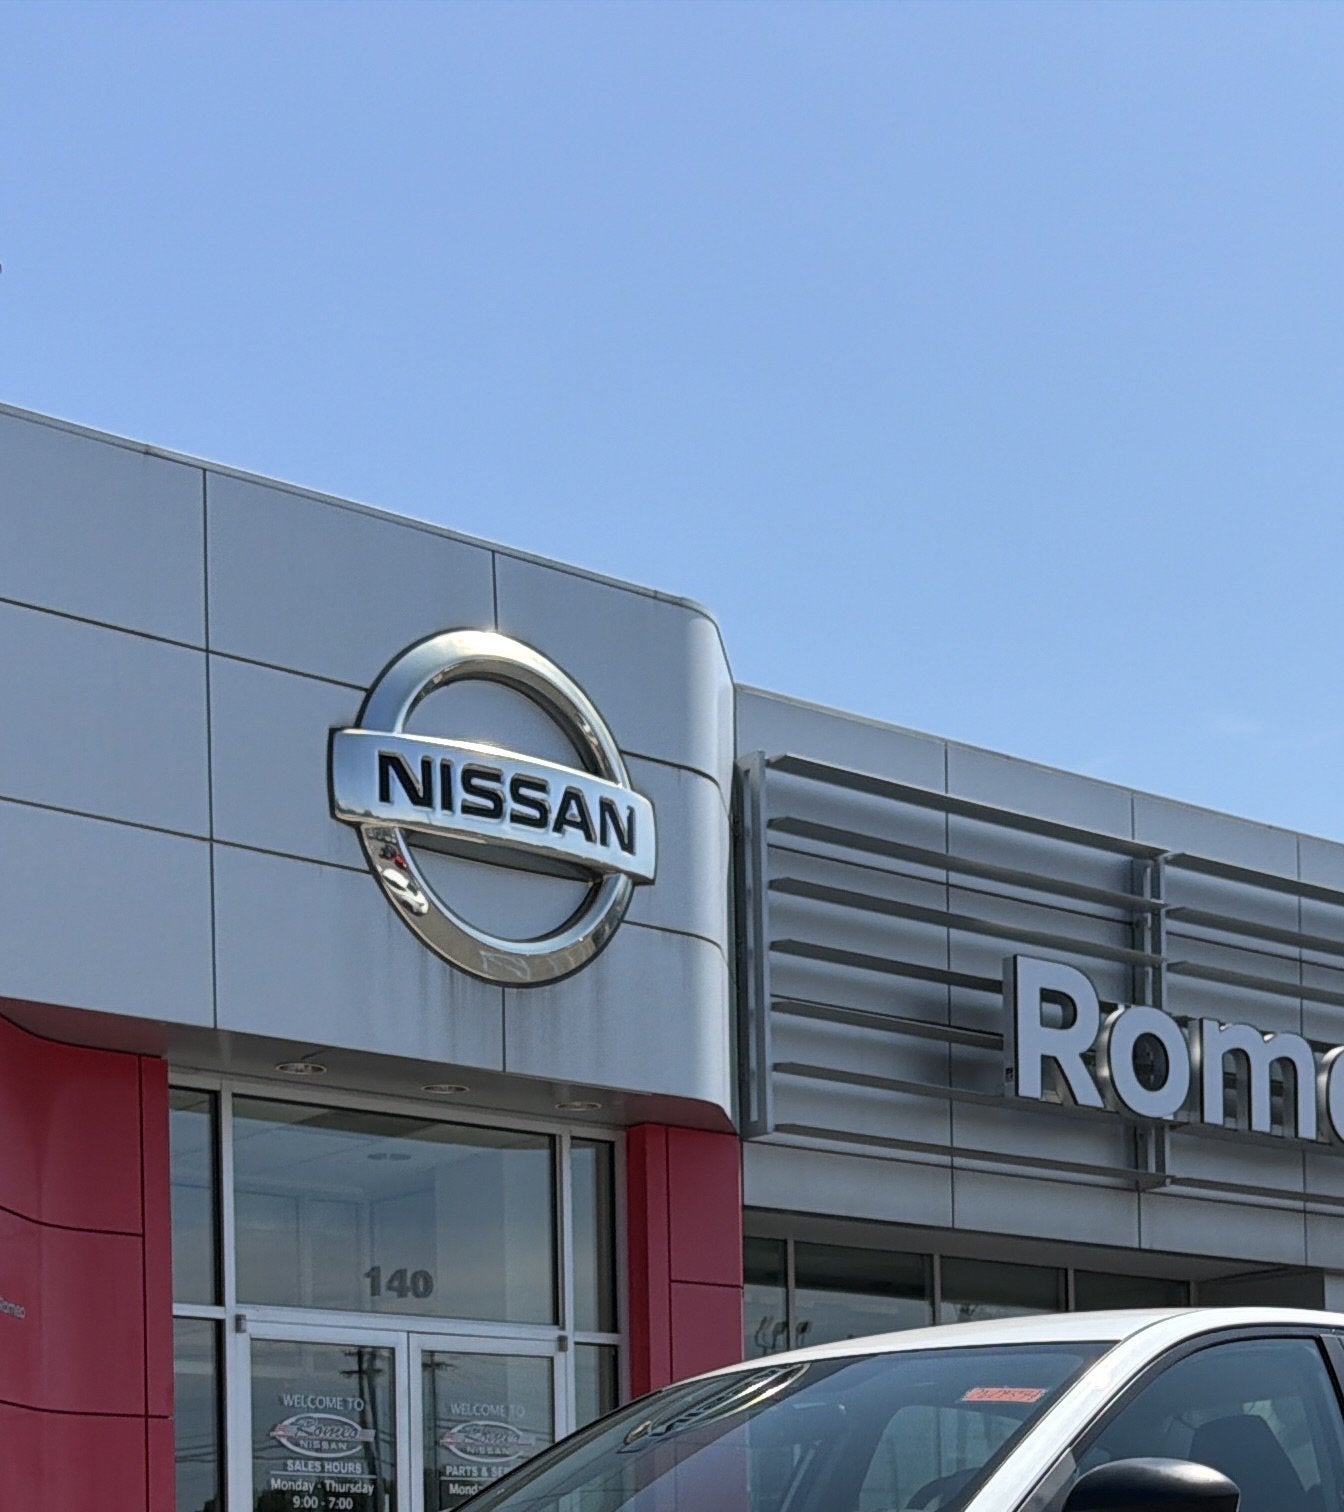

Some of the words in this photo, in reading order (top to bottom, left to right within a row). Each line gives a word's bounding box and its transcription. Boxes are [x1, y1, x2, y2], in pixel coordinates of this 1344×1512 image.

[377, 750, 636, 856] NISSAN
[363, 1266, 434, 1298] 140
[283, 1394, 343, 1410] WELCOME
[348, 1397, 364, 1411] TO
[451, 1402, 505, 1417] WELCOME
[509, 1405, 525, 1417] TO
[299, 1440, 348, 1450] NISSAN
[287, 1460, 321, 1472] SALES
[324, 1461, 362, 1474] HOURS
[446, 1465, 477, 1477] PARTS
[481, 1466, 488, 1477] &
[271, 1478, 315, 1494] Monday
[324, 1480, 375, 1496] Thursday
[293, 1496, 318, 1508] 9:00
[328, 1497, 353, 1510] 7:00
